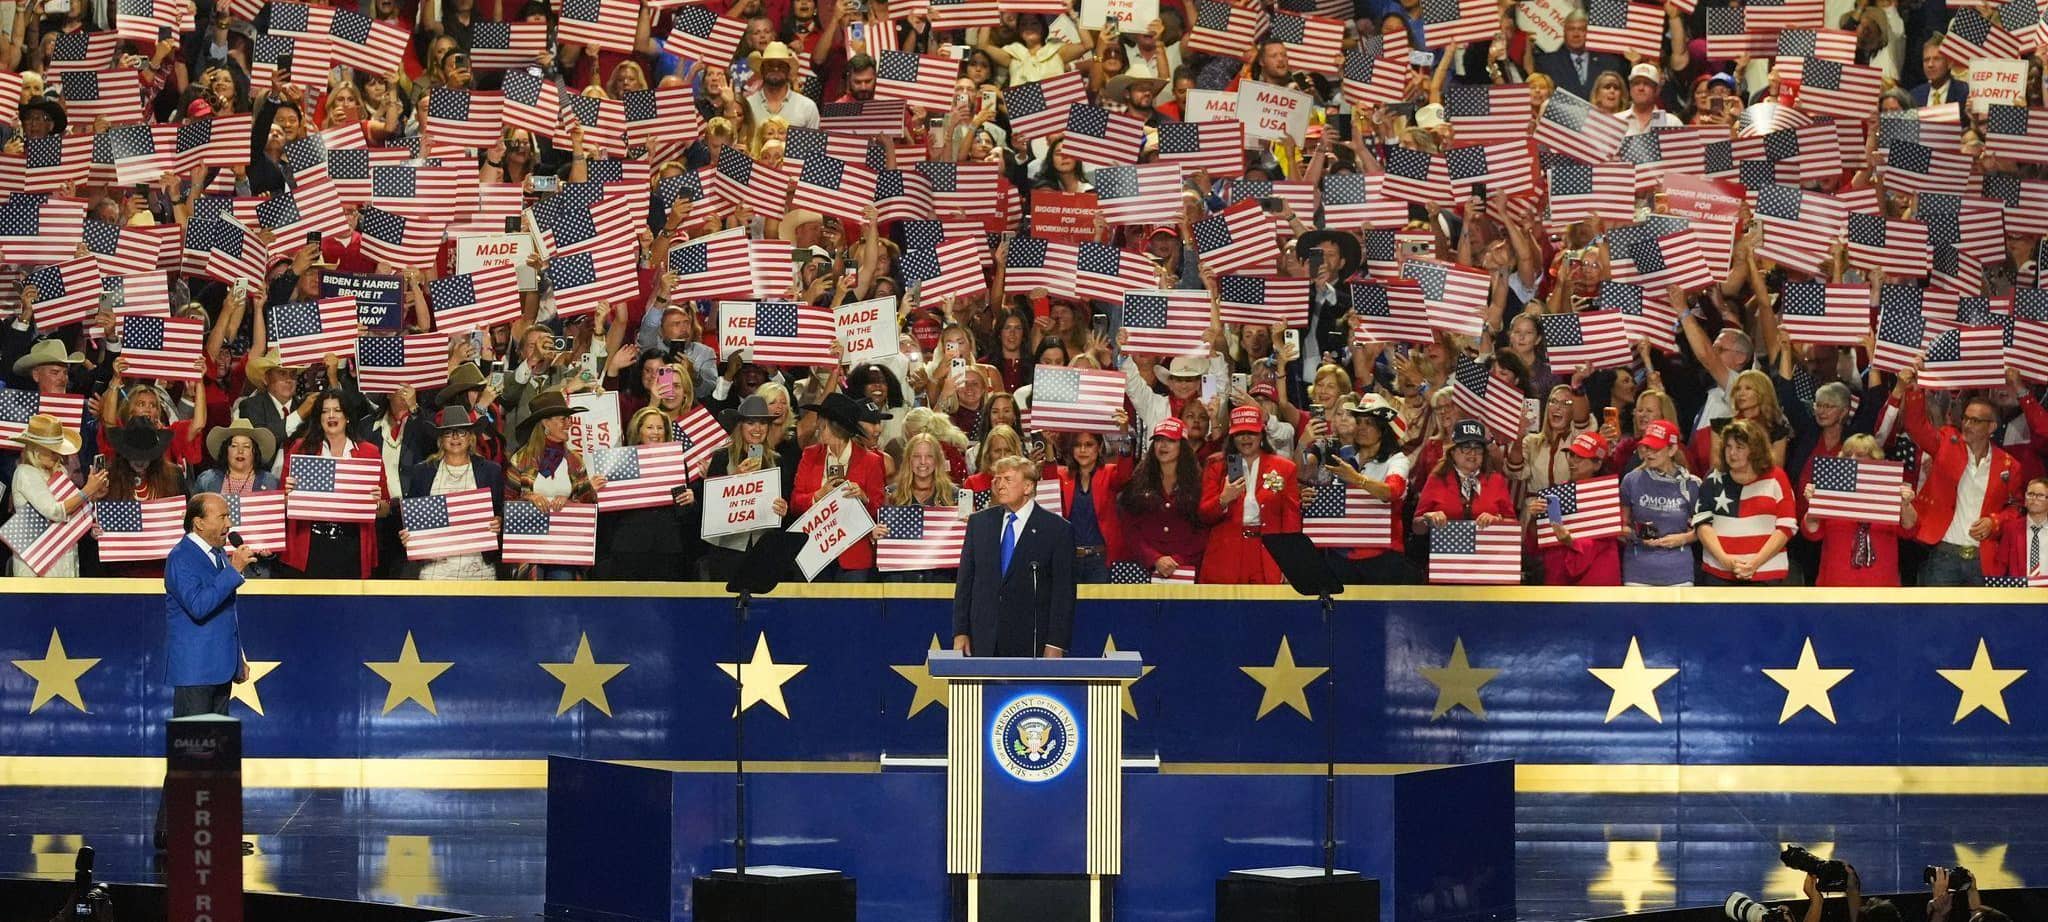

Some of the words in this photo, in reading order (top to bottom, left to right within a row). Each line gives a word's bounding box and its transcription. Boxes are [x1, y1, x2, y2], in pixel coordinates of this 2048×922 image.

[1107, 10, 1133, 21] SA
[1995, 72, 2019, 83] THE
[1205, 99, 1237, 112] MAD
[1256, 91, 1298, 110] MADE
[1262, 106, 1270, 114] IN
[1273, 108, 1288, 118] THE
[1259, 117, 1287, 132] USA
[1034, 205, 1061, 214] BIGGER
[1062, 207, 1095, 215] PAYCHEC
[1061, 216, 1076, 224] FOR
[1035, 224, 1069, 233] WORKING
[1070, 227, 1095, 235] FAMILI
[476, 243, 518, 257] MADE
[322, 275, 352, 287] BIDEN
[362, 280, 400, 289] HARRIS
[338, 288, 372, 299] BROKE
[373, 291, 384, 299] IT
[359, 305, 369, 314] IS
[371, 306, 387, 315] ON
[359, 316, 382, 325] WAY
[728, 316, 756, 328] KEE
[838, 309, 879, 327] MADE
[846, 328, 855, 337] IN
[857, 326, 872, 335] THE
[847, 338, 874, 353] USA
[585, 423, 593, 442] THE
[1462, 424, 1482, 436] USA
[722, 480, 764, 498] MADE
[729, 500, 739, 508] IN
[740, 498, 756, 507] THE
[1648, 496, 1681, 505] MOMS
[727, 511, 755, 524] USA
[802, 500, 840, 534] MADE
[813, 531, 822, 542] IN
[822, 519, 838, 533] THE
[819, 527, 847, 554] USA
[1046, 702, 1058, 712] THE
[994, 698, 1034, 736] PRESIDENT
[1058, 710, 1076, 746] UNITED
[174, 738, 216, 748] DALLAS
[1006, 758, 1026, 777] SEAL
[1042, 750, 1072, 777] STATES
[193, 790, 212, 886] FRONT
